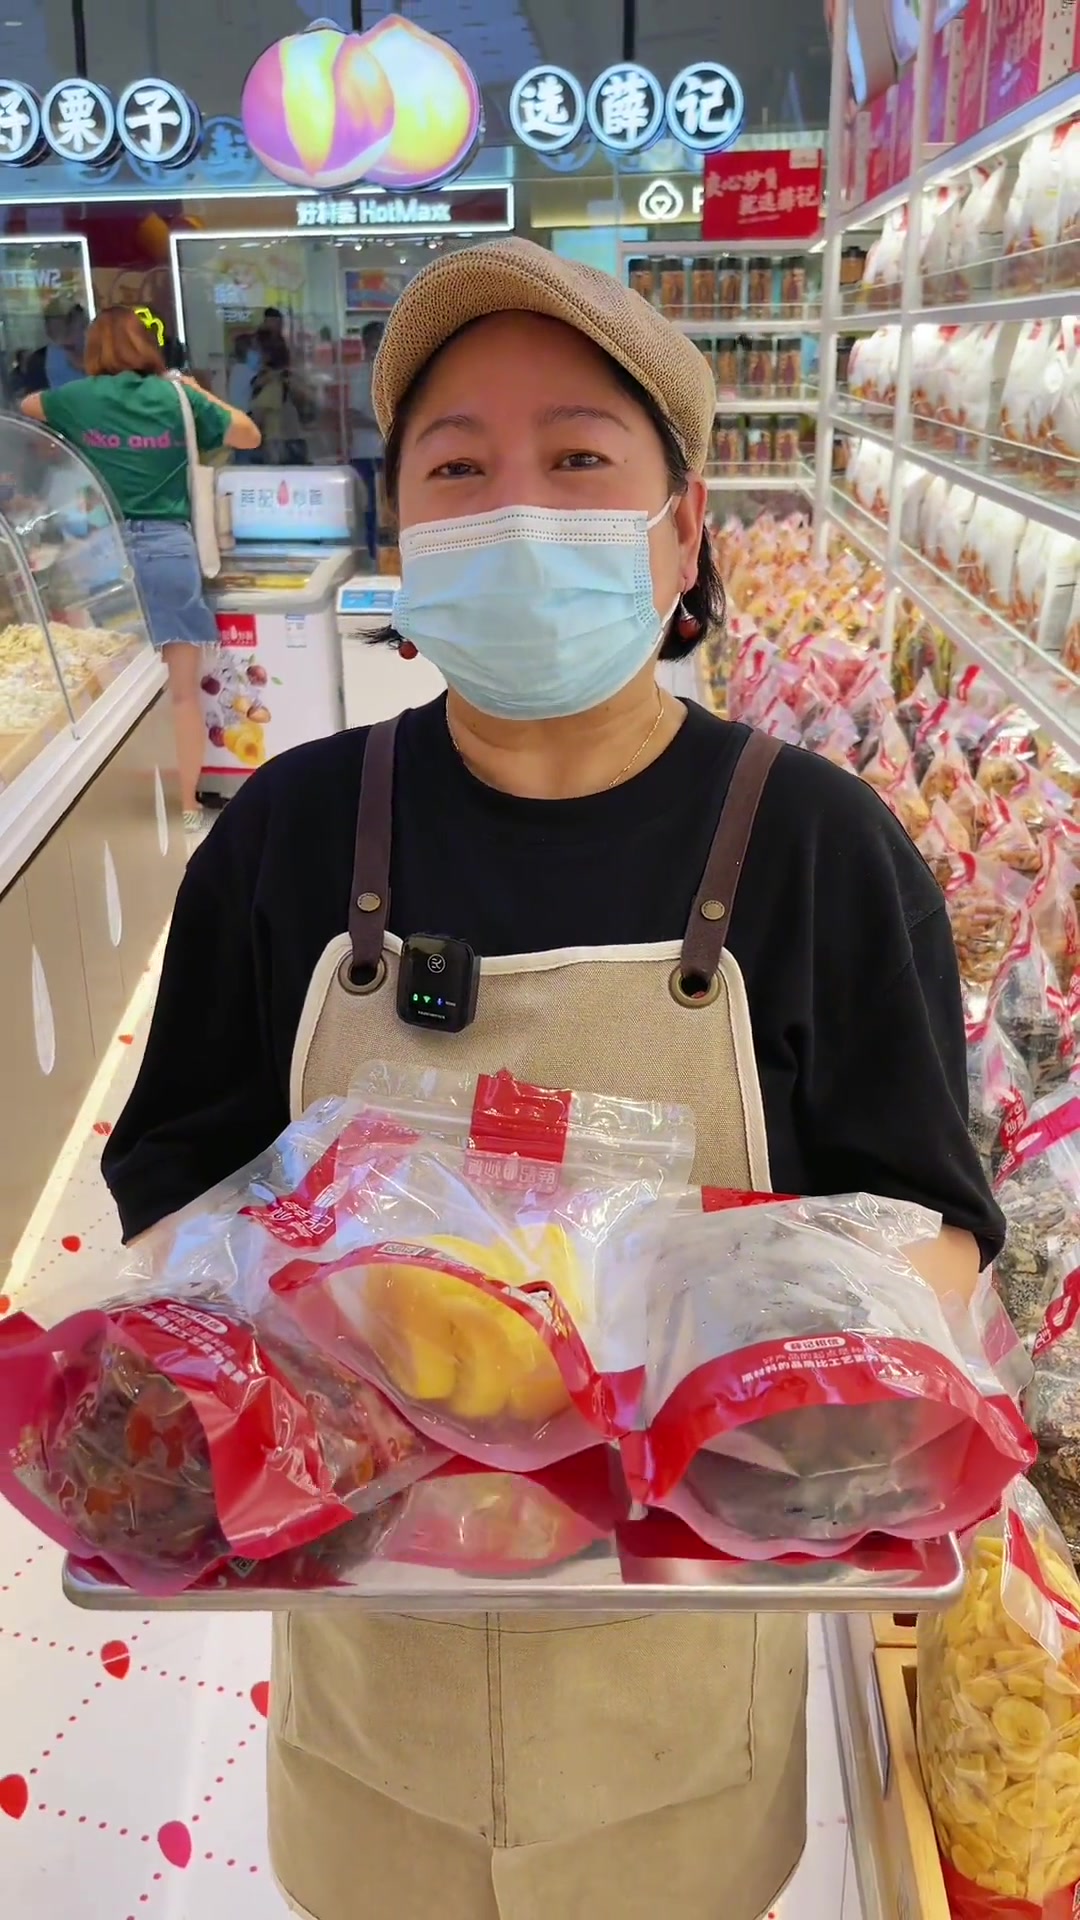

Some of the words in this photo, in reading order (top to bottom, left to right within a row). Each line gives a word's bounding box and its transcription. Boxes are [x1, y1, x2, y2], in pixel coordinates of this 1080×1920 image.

[0, 88, 180, 154] 好栗子
[521, 72, 733, 142] 选薛记
[128, 430, 171, 449] and
